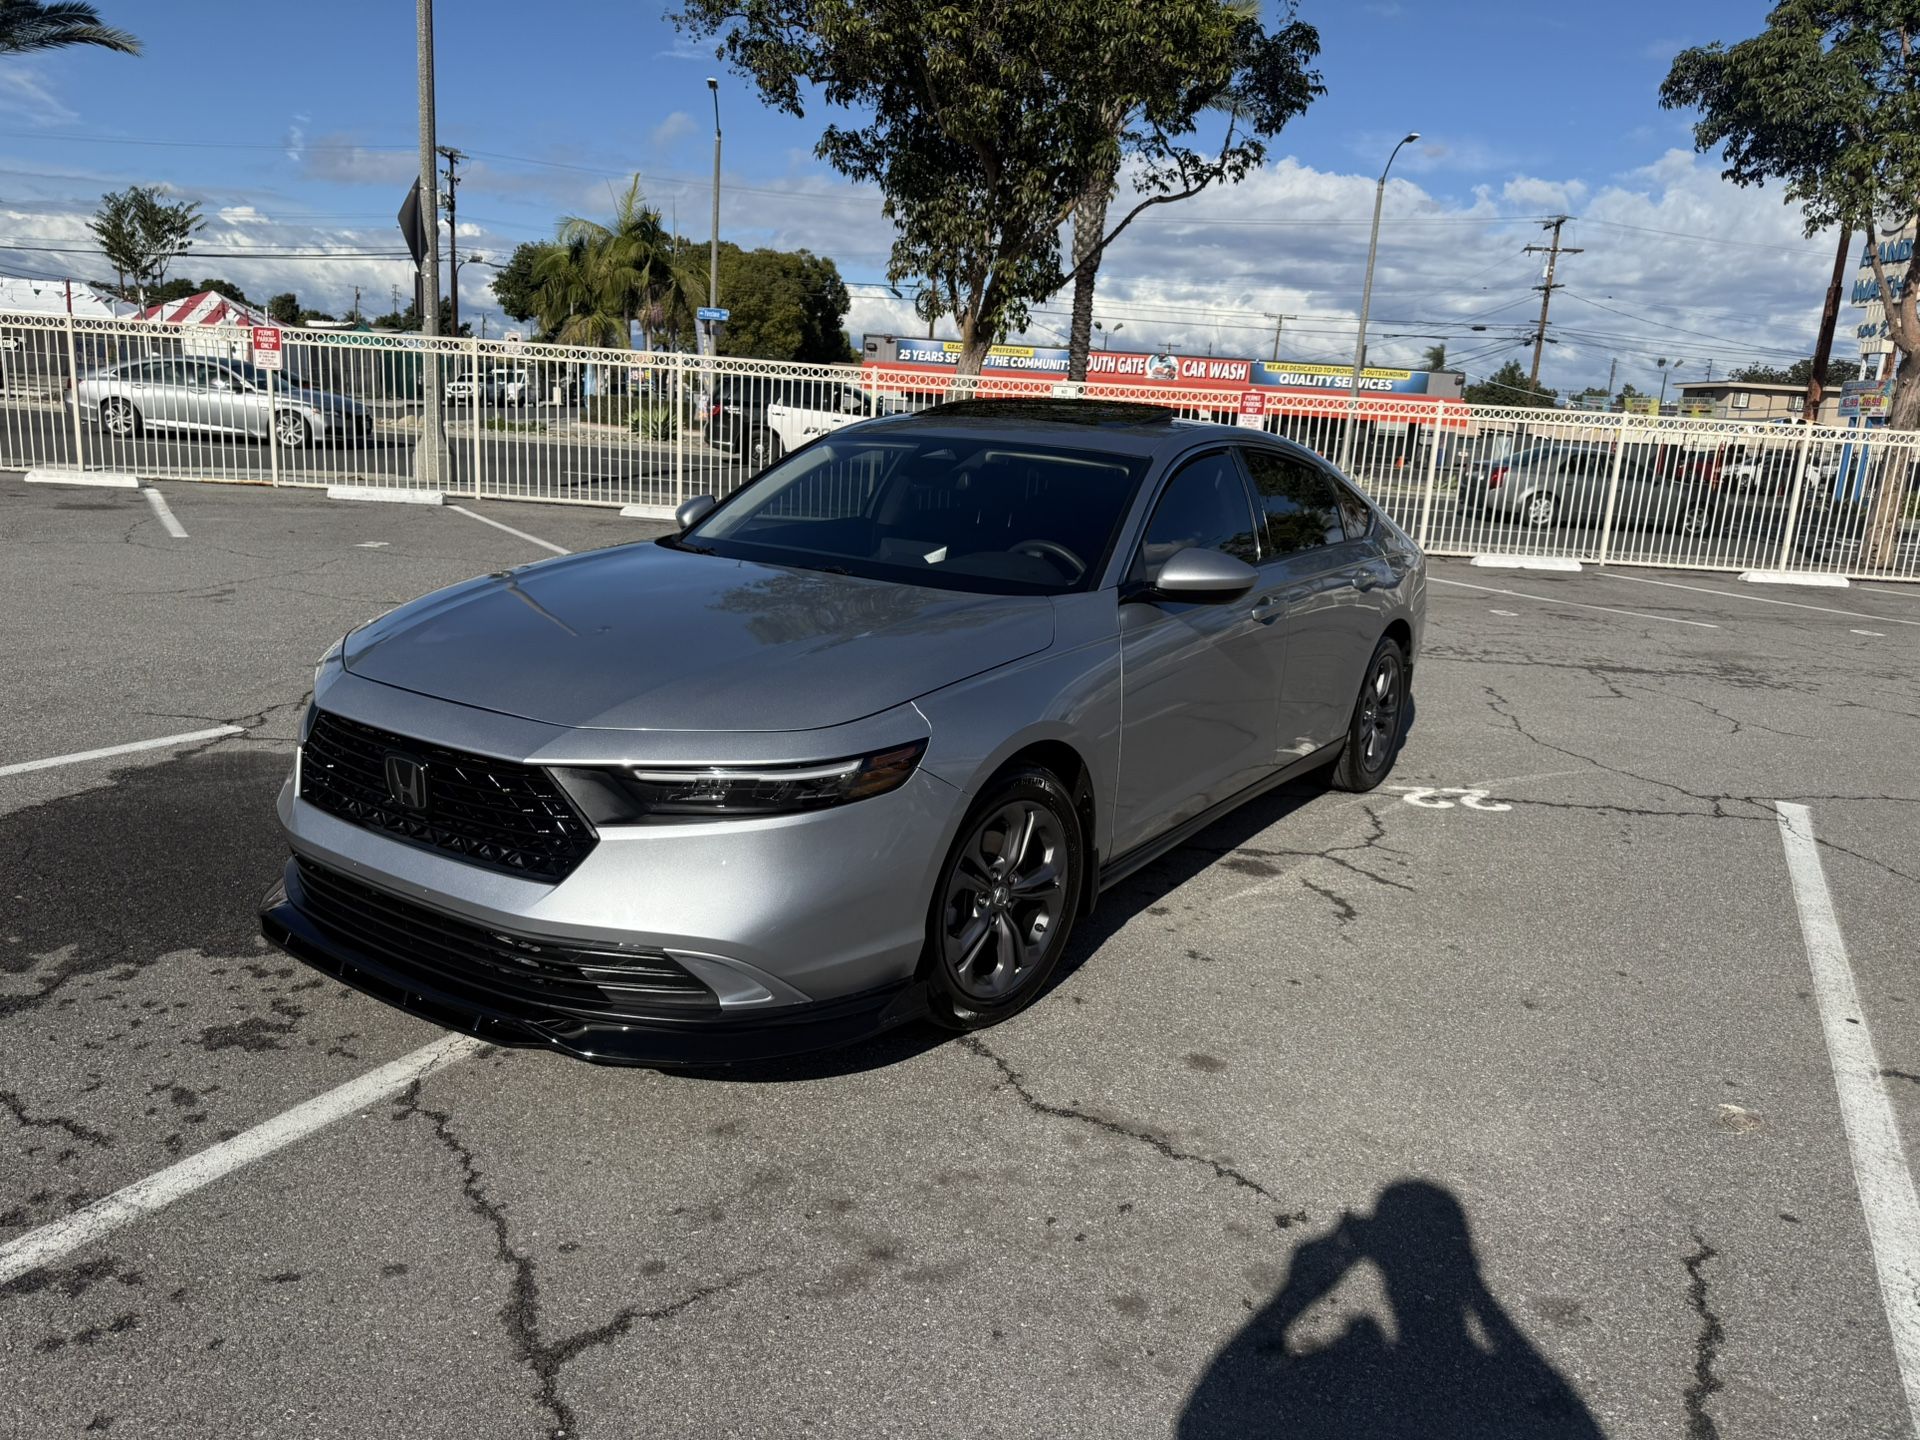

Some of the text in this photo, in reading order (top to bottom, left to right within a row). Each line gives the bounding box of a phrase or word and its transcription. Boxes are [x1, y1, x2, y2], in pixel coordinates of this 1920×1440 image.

[992, 347, 1029, 355] PREFERENCIA
[899, 349, 911, 360] 25
[912, 350, 944, 363] YEARS
[990, 355, 1009, 367] THE
[1010, 356, 1070, 371] COMMUNIT
[1086, 355, 1248, 381] OUTH GATE CAR WASH
[1289, 365, 1323, 373] DEDICATED
[1366, 369, 1409, 378] OUTSTANDING
[1280, 373, 1333, 387] QUALITY
